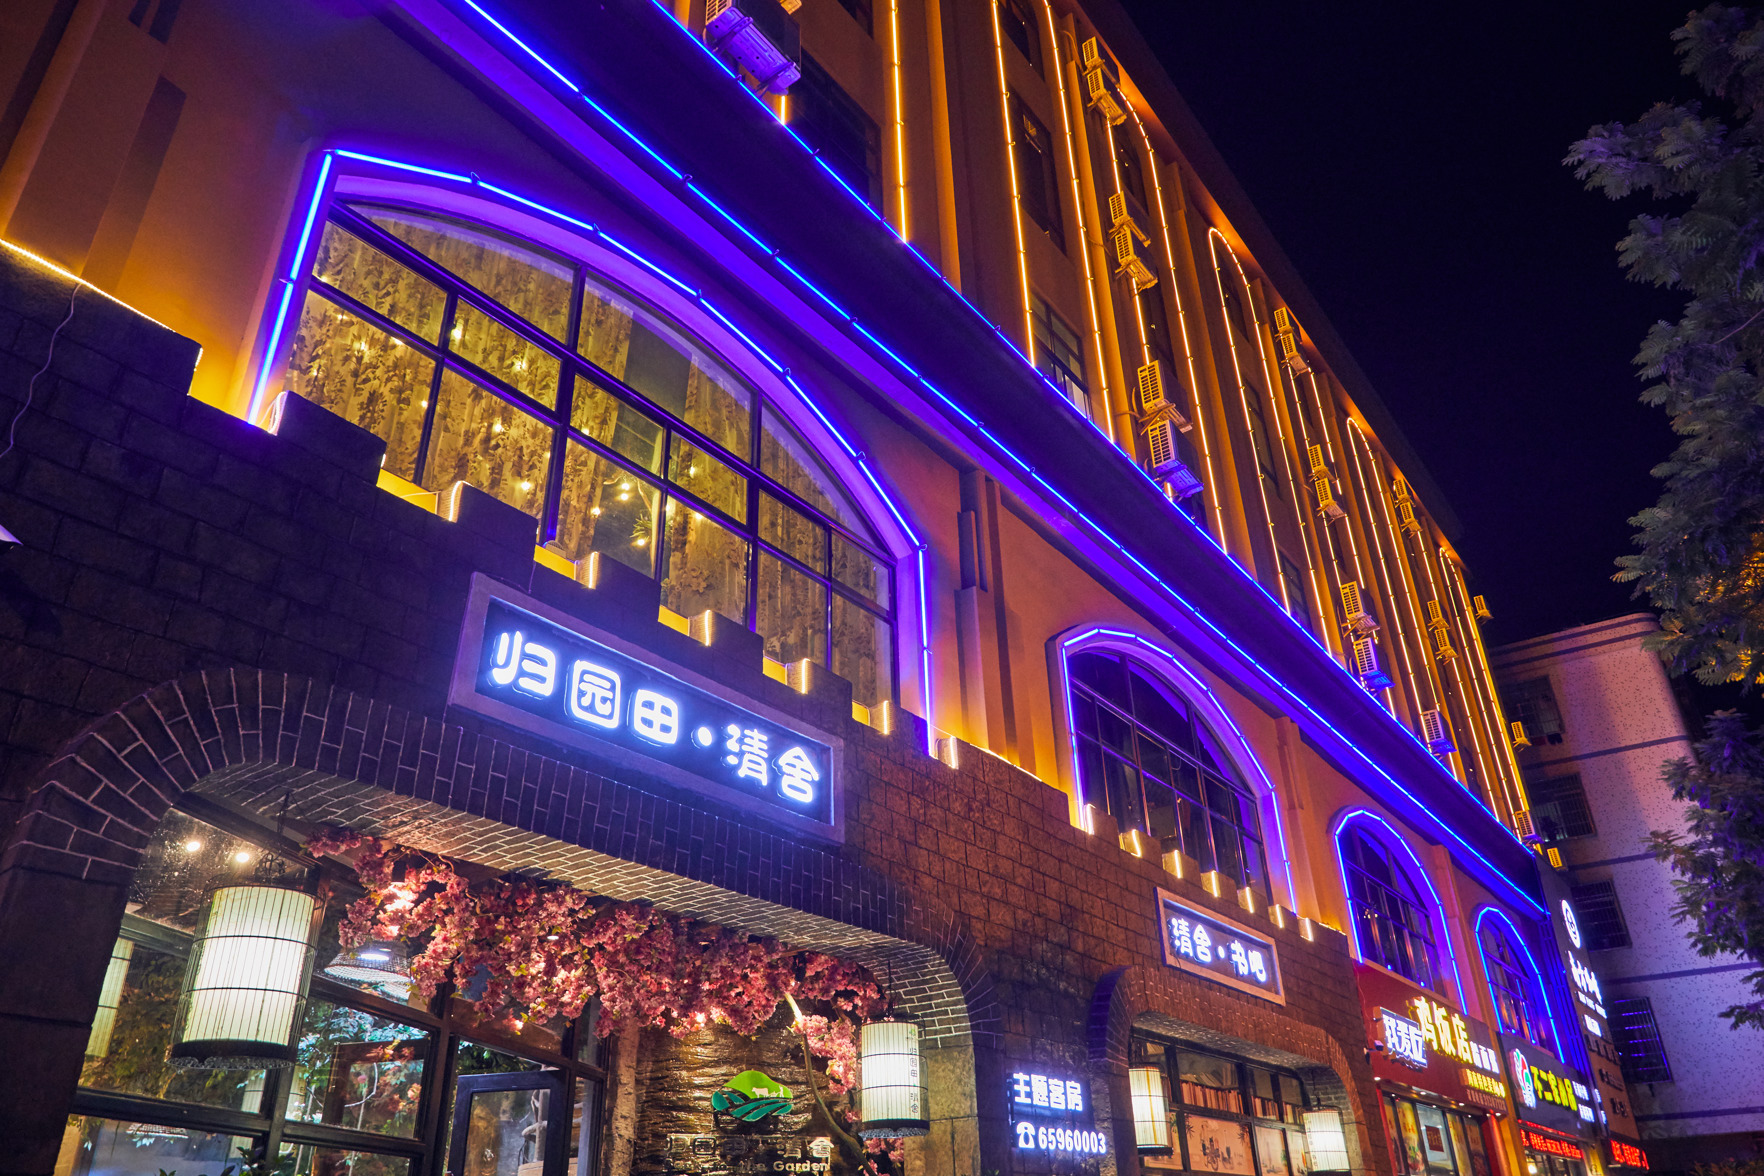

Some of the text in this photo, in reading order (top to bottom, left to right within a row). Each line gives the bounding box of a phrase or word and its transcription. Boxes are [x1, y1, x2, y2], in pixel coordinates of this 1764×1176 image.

[492, 631, 819, 803] 归园田·清舍
[1171, 917, 1267, 982] 清舍·书吧
[1013, 1072, 1083, 1112] 主题客房
[1038, 1126, 1107, 1154] 65960003
[773, 1159, 830, 1173] Garden
